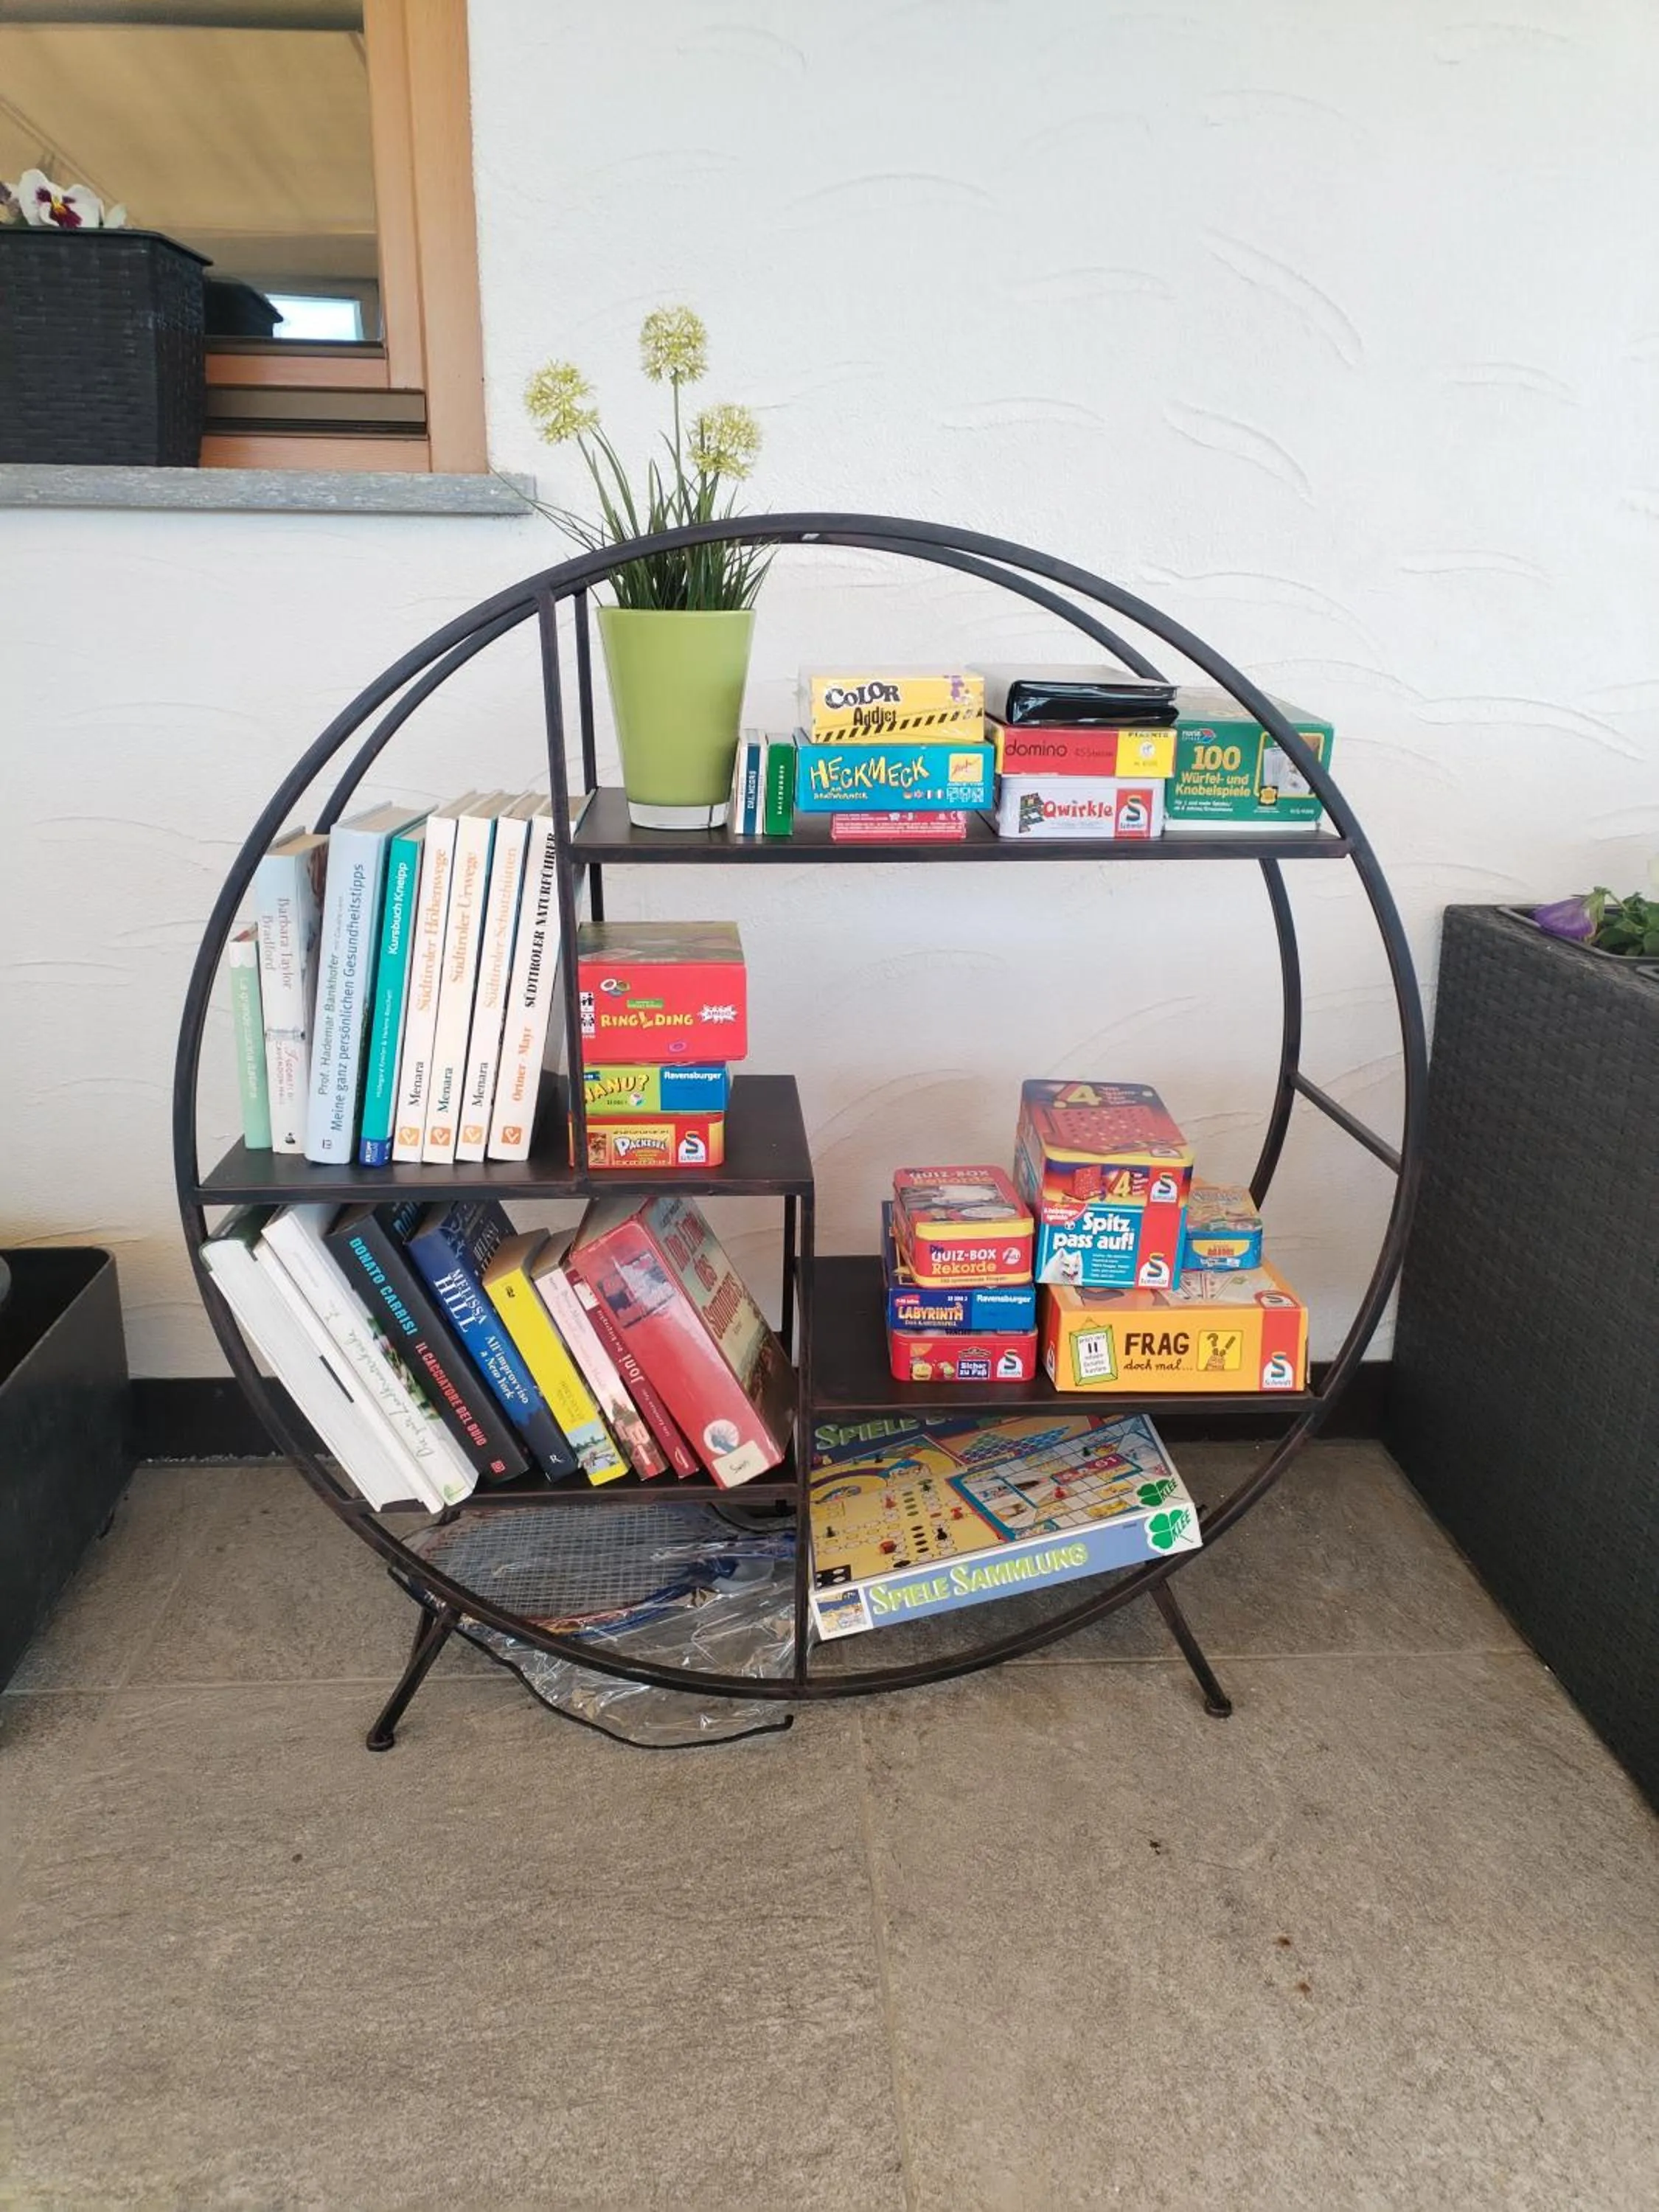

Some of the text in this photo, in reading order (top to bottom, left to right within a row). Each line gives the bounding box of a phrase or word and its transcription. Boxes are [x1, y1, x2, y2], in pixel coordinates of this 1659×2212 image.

[853, 706, 897, 729] Addict
[1005, 737, 1068, 757] domino
[1192, 745, 1242, 771] 100
[810, 754, 931, 791] HECKMECK
[1181, 771, 1249, 785] Würfel- und
[1175, 783, 1251, 799] Knobelspiele
[1042, 799, 1114, 821] Qwirkle
[388, 861, 409, 955] Kursbuch Kneipp
[450, 851, 479, 985] Südtiroler Urwege
[524, 832, 557, 1009] SÜDTIROLER NATURFÜHRER
[417, 847, 448, 1012] Südtiroler Höhenwege
[484, 936, 505, 1010] Südtiroler
[331, 863, 365, 1133] Meine ganz persönlichen Gesundheitstipps
[318, 953, 339, 1096] Prof. Hademar Bankhofer
[512, 1025, 532, 1103] Ortner Mayr
[664, 1071, 722, 1081] Ravensburger
[408, 1060, 425, 1107] Menara
[437, 1066, 454, 1113] Menara
[471, 1060, 490, 1108] Menara
[1082, 1211, 1130, 1234] Spitz
[931, 1248, 996, 1262] QUIZ-BOX
[1053, 1233, 1135, 1251] pass auf!
[931, 1262, 997, 1275] Rekorde
[349, 1237, 385, 1284] DONATO
[380, 1280, 418, 1337] CARRISI
[451, 1267, 489, 1326] MELISSA
[976, 1295, 1032, 1304] Ravensburger
[434, 1276, 478, 1334] HILL
[898, 1305, 963, 1321] LABYRINTH
[1088, 1341, 1098, 1354] 11
[1124, 1332, 1189, 1356] FRAG
[484, 1335, 530, 1405] All'improvviso
[487, 1355, 503, 1382] New
[497, 1376, 515, 1402] York
[619, 1353, 645, 1384] Joni
[1124, 1359, 1193, 1371] doch mal...
[415, 1342, 489, 1447] IL CACCIATORE DEL BUIO
[815, 1419, 921, 1450] SPIELE
[1161, 1478, 1178, 1501] KLEE
[1172, 1509, 1192, 1543] KLEE
[869, 1543, 1088, 1615] SPIELE SAMMLUNG
